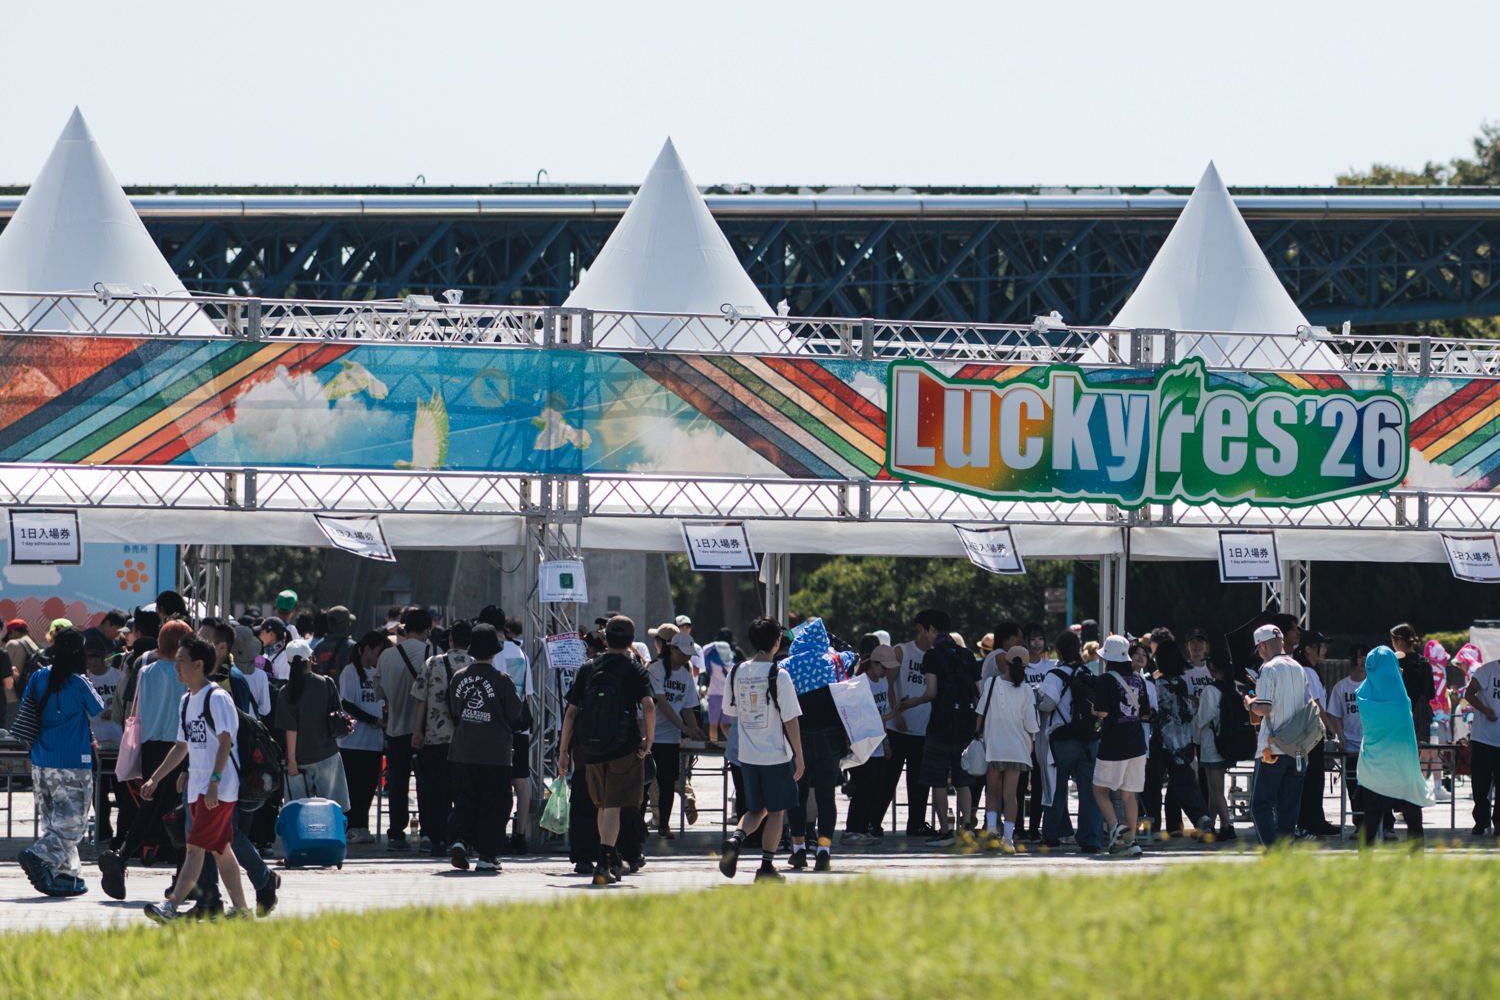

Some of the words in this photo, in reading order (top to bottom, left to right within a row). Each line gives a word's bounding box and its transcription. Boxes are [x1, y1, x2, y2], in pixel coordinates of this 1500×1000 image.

[21, 528, 71, 540] 1日入場券
[695, 538, 740, 549] 1日入場券
[1229, 547, 1269, 558] 1日入場券
[907, 672, 923, 685] Fes
[1025, 673, 1046, 684] Luck
[95, 684, 116, 696] cky
[663, 677, 686, 693] Lucky
